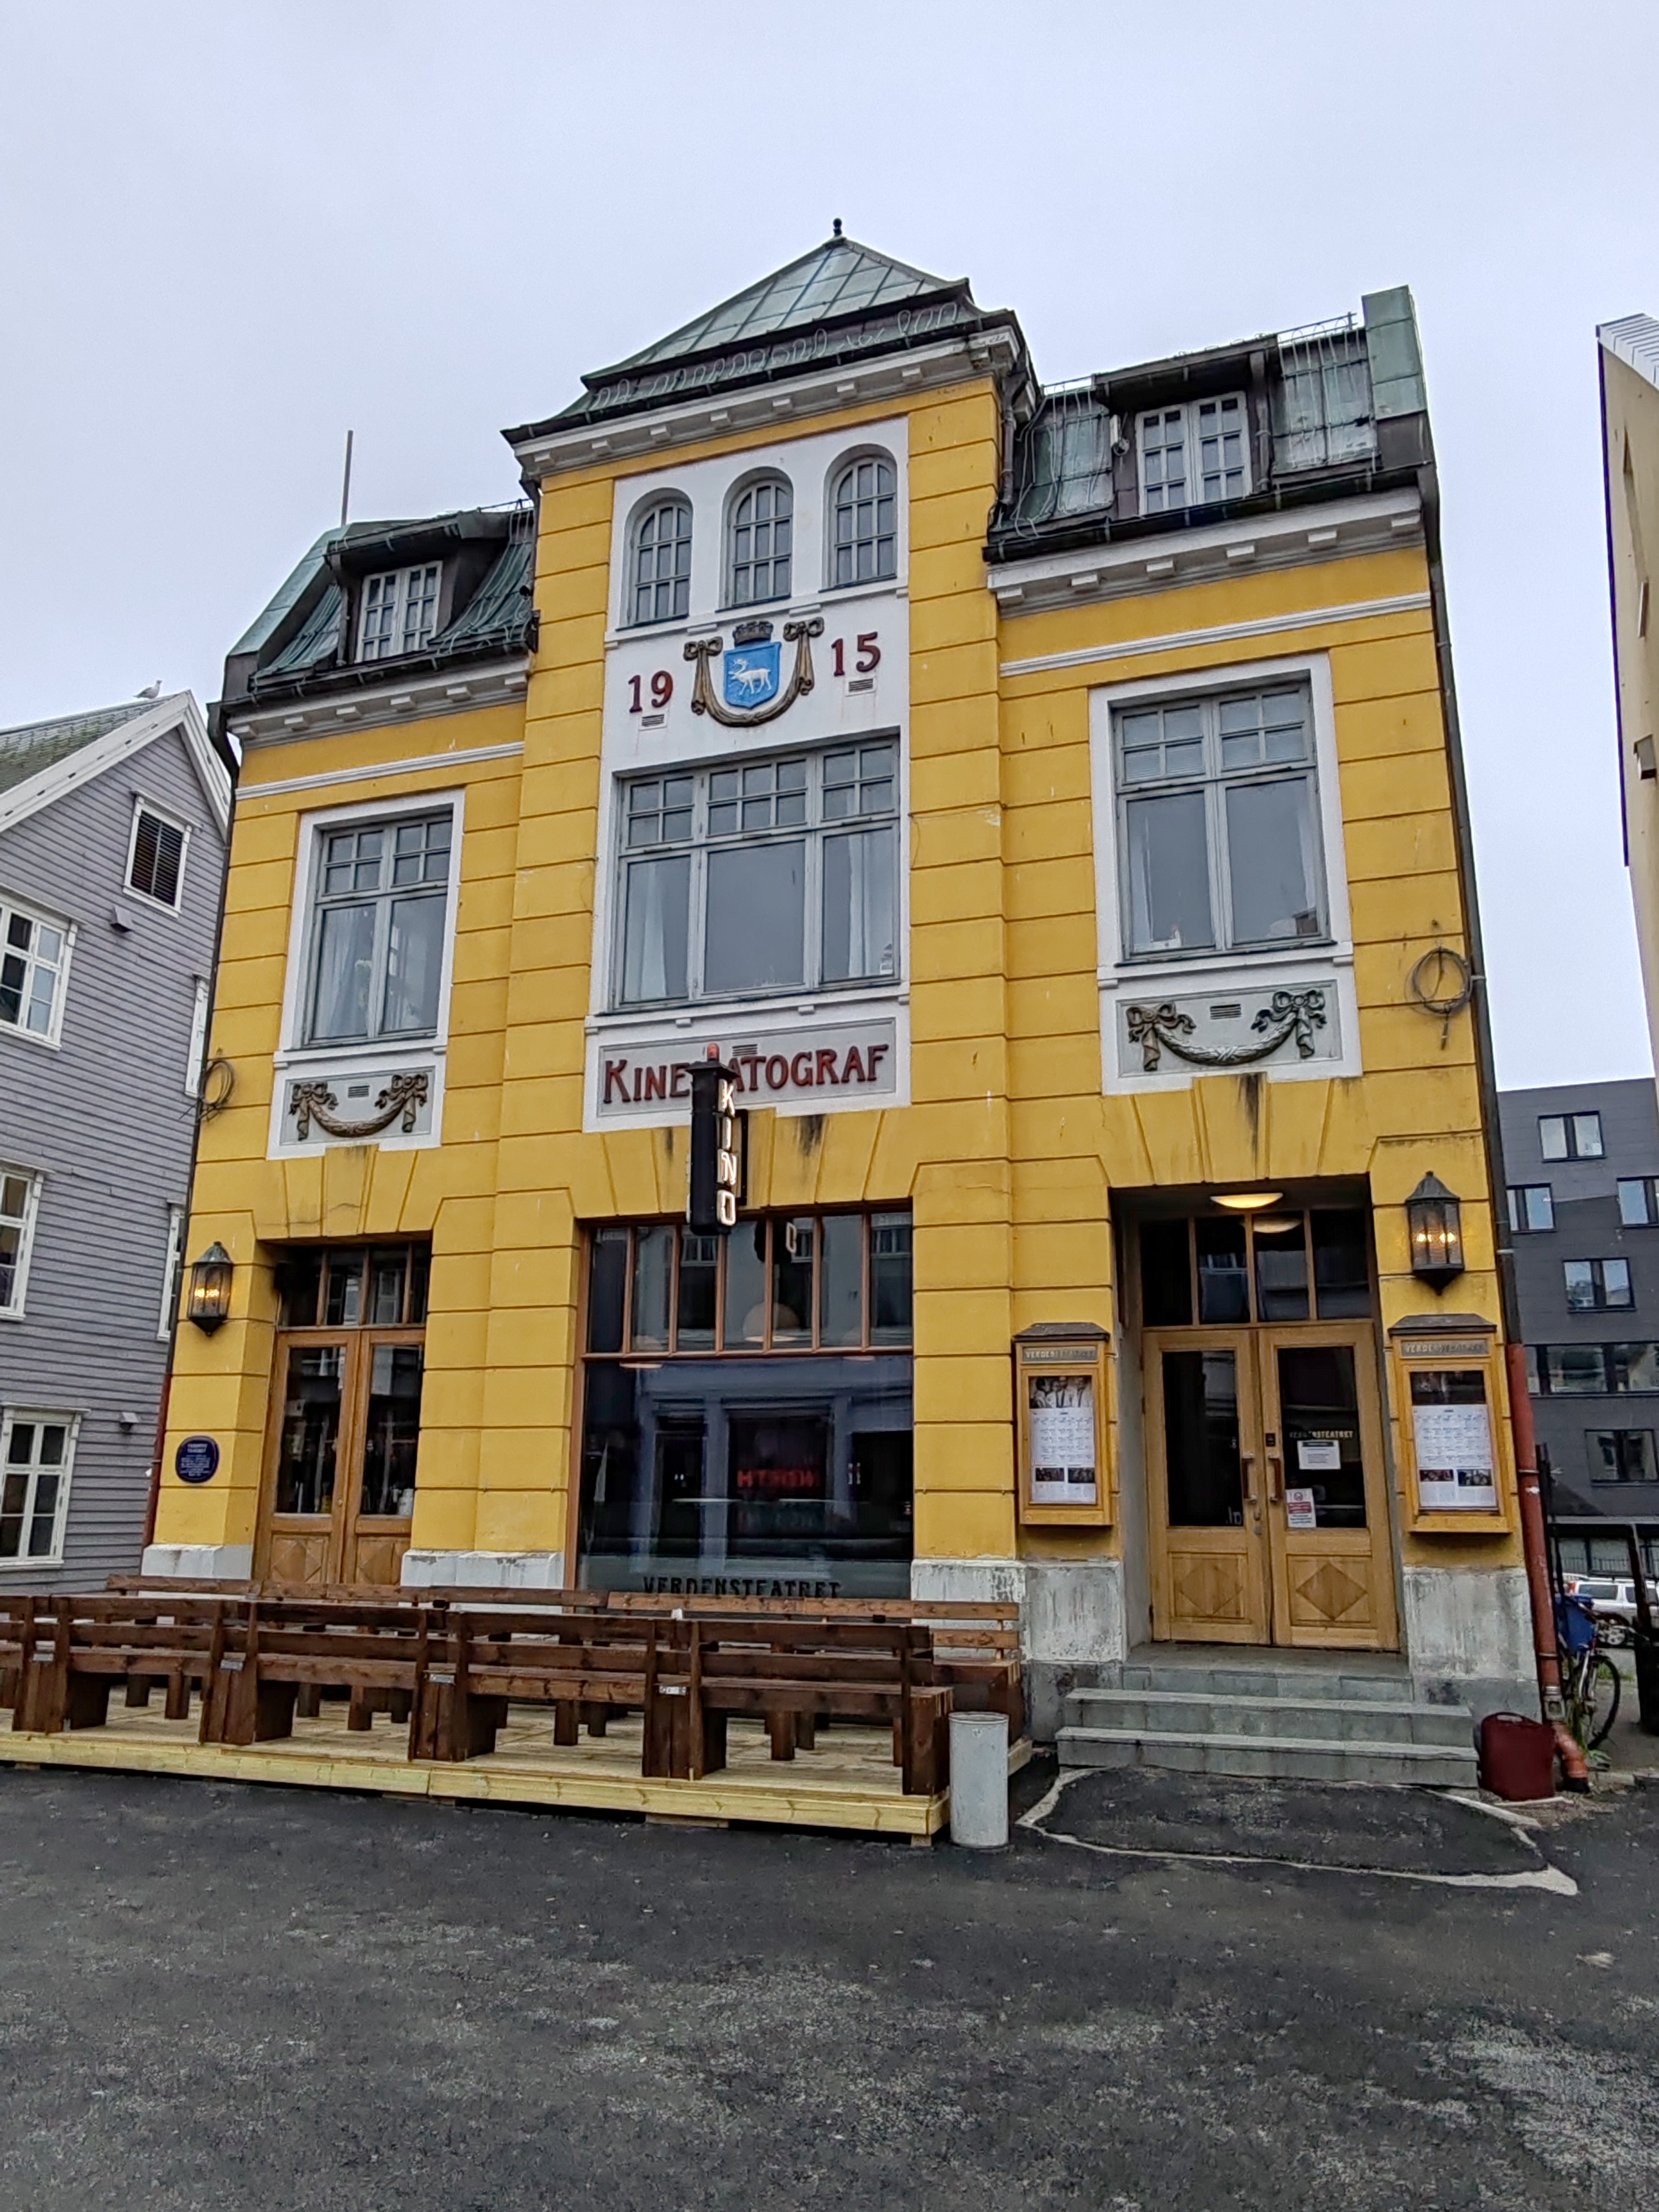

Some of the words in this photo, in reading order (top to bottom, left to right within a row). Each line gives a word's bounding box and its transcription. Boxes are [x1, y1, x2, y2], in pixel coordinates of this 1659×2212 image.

[628, 670, 674, 713] 19
[831, 631, 881, 677] 15
[603, 1043, 889, 1104] KINEATOGRAF
[717, 1078, 738, 1227] KINO
[643, 1577, 841, 1598] VERDENSTEATRET
